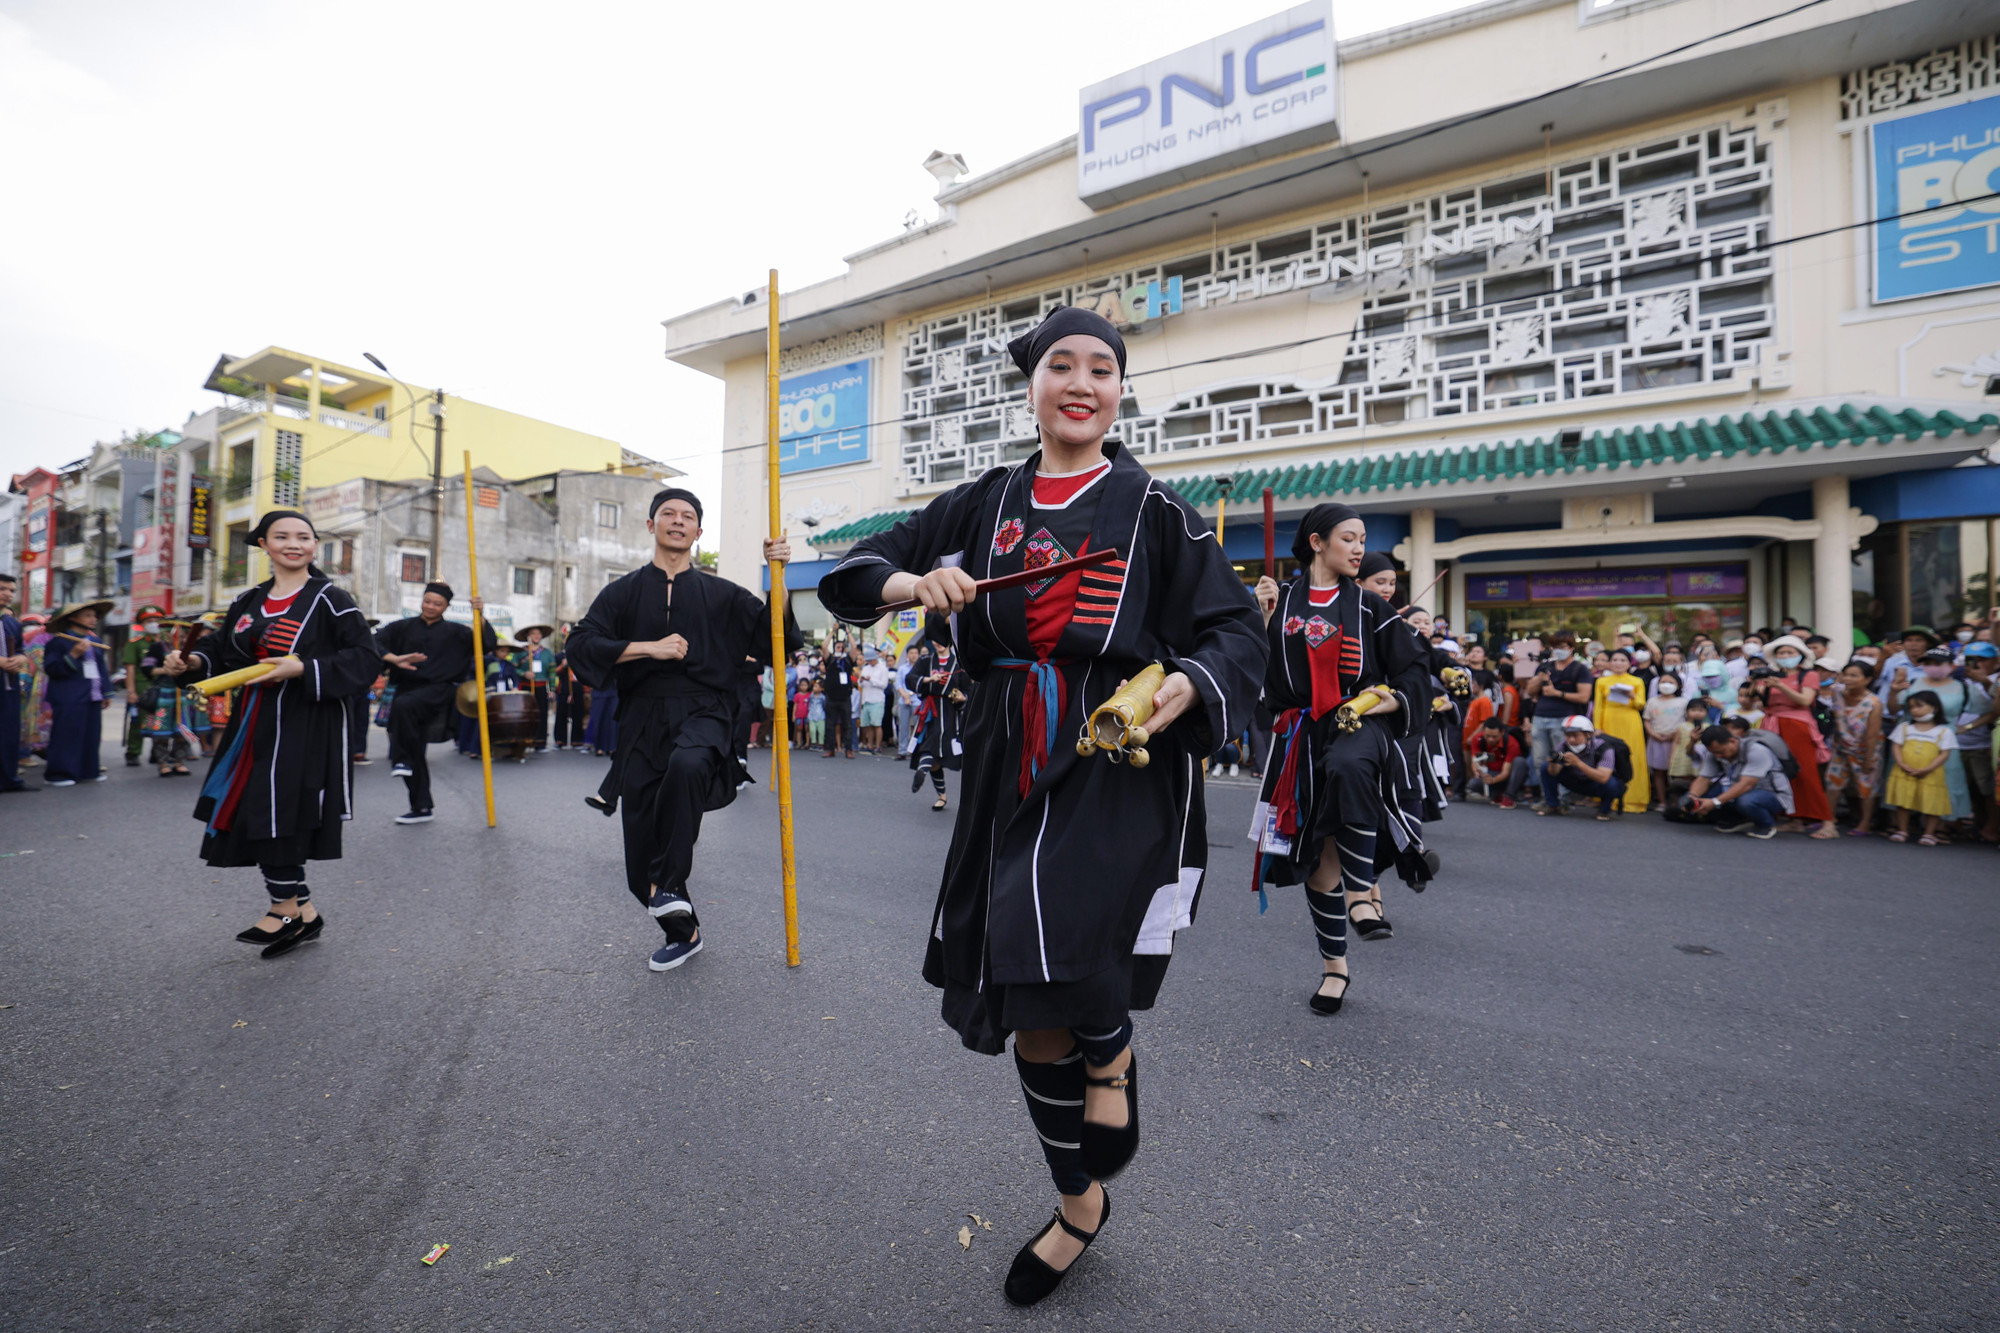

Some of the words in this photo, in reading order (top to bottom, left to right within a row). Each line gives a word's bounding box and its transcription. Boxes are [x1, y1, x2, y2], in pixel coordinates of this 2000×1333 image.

[1083, 18, 1325, 155] PNC
[1083, 133, 1178, 176] PHUONG
[1188, 112, 1241, 142] NAM
[1253, 84, 1328, 121] CORP
[1897, 127, 2000, 165] PHU
[1425, 209, 1554, 261] NAM
[832, 375, 863, 391] NAM
